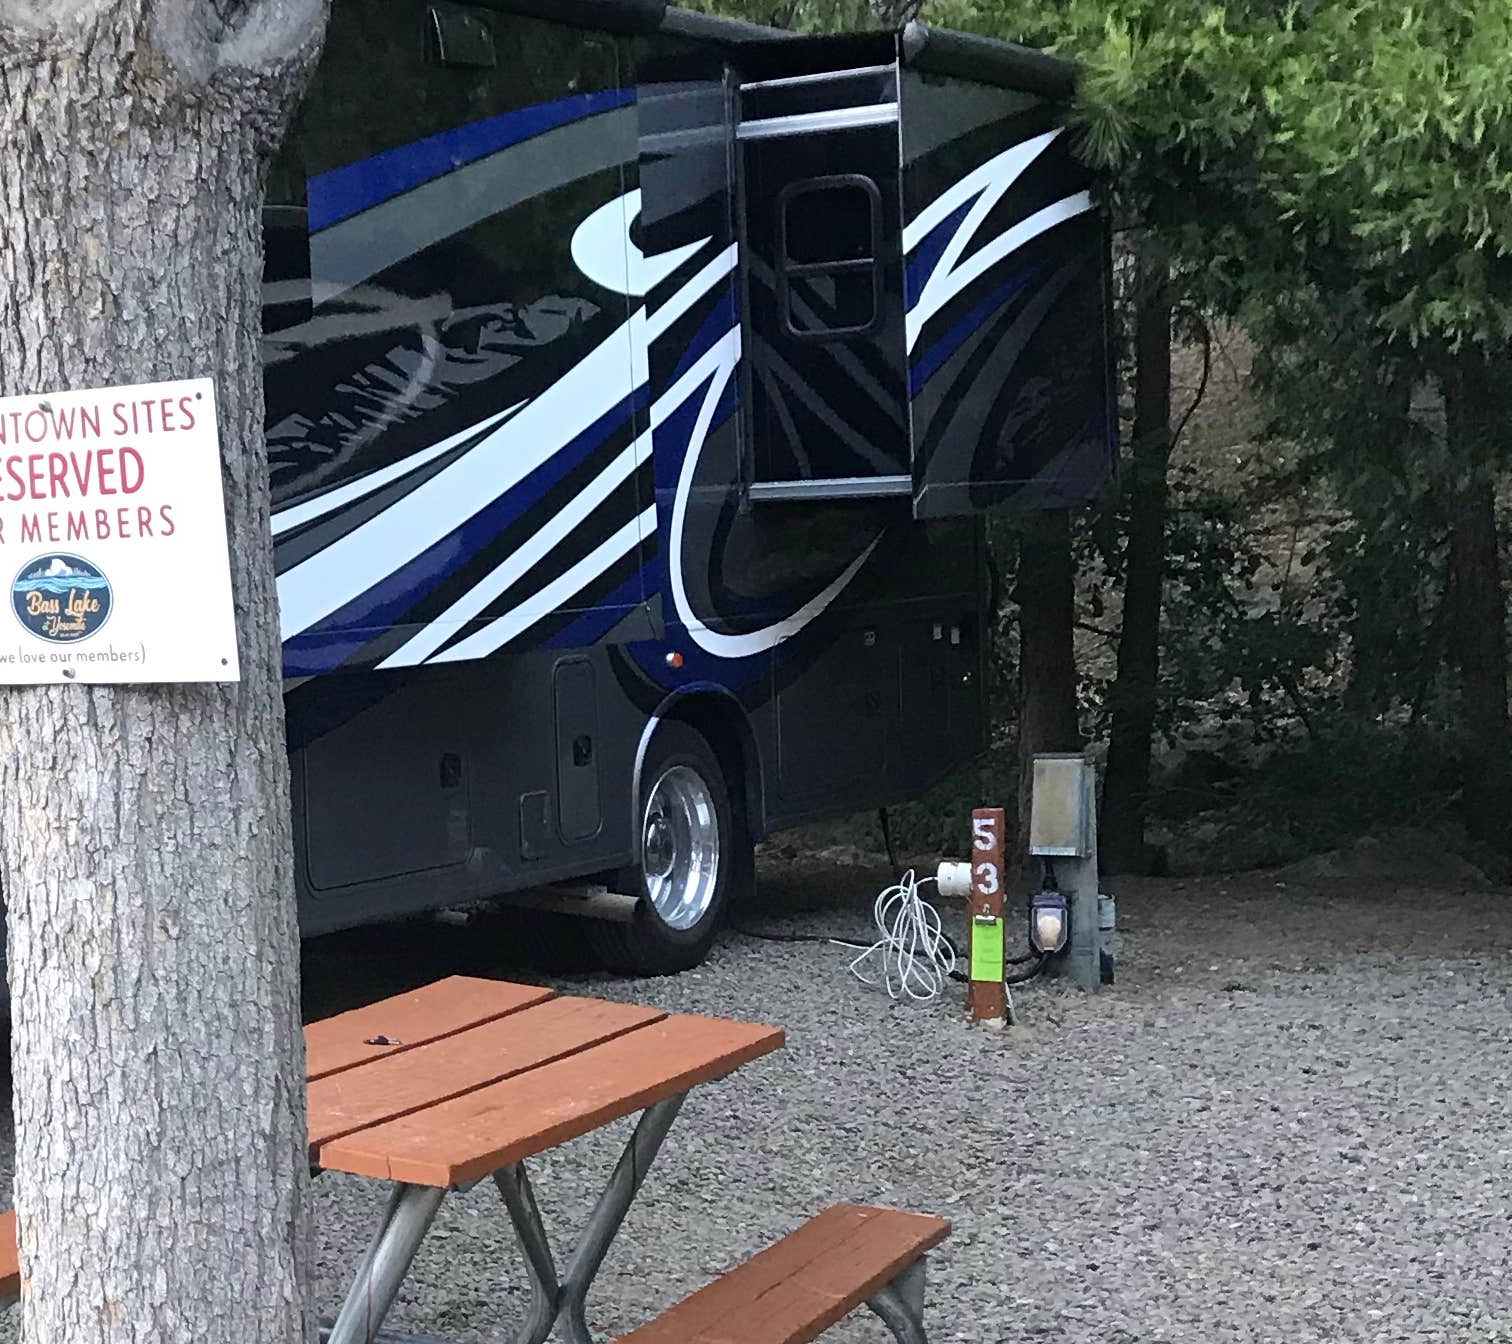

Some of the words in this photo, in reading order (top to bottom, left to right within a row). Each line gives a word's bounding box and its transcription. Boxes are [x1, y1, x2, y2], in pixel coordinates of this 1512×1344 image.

[112, 396, 196, 436] SITES
[20, 505, 176, 544] MEMBERS
[26, 590, 60, 616] Bass
[64, 588, 101, 616] Lake
[19, 644, 46, 664] love
[50, 652, 72, 663] our
[76, 641, 146, 665] members)
